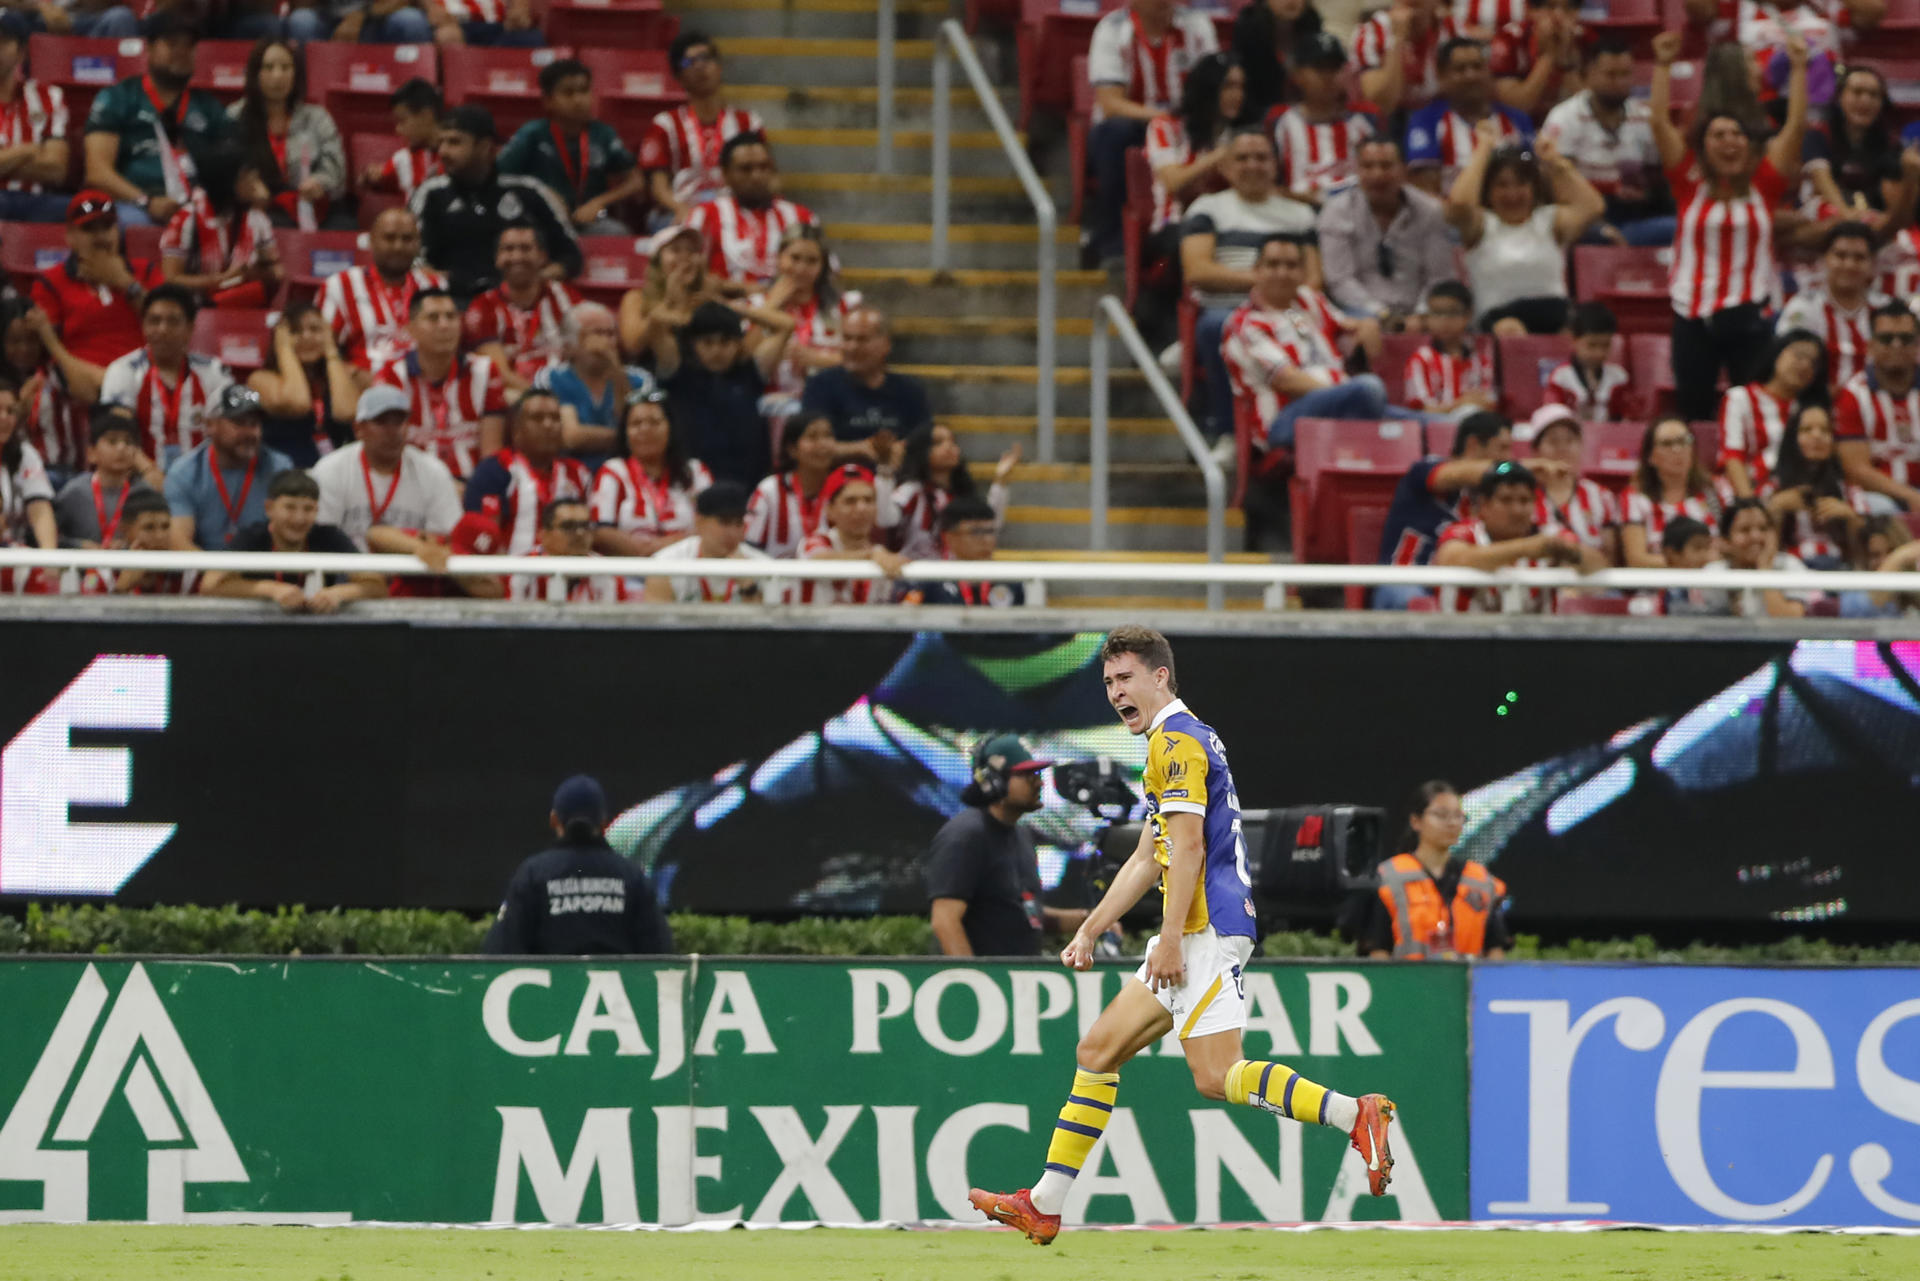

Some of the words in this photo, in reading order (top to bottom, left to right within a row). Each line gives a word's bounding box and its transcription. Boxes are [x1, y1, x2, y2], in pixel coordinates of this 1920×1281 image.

[549, 895, 625, 915] ZAPOPAN
[482, 968, 778, 1080] CAJA
[848, 968, 1383, 1057] POPAR
[490, 1102, 1442, 1224] MEXICANA
